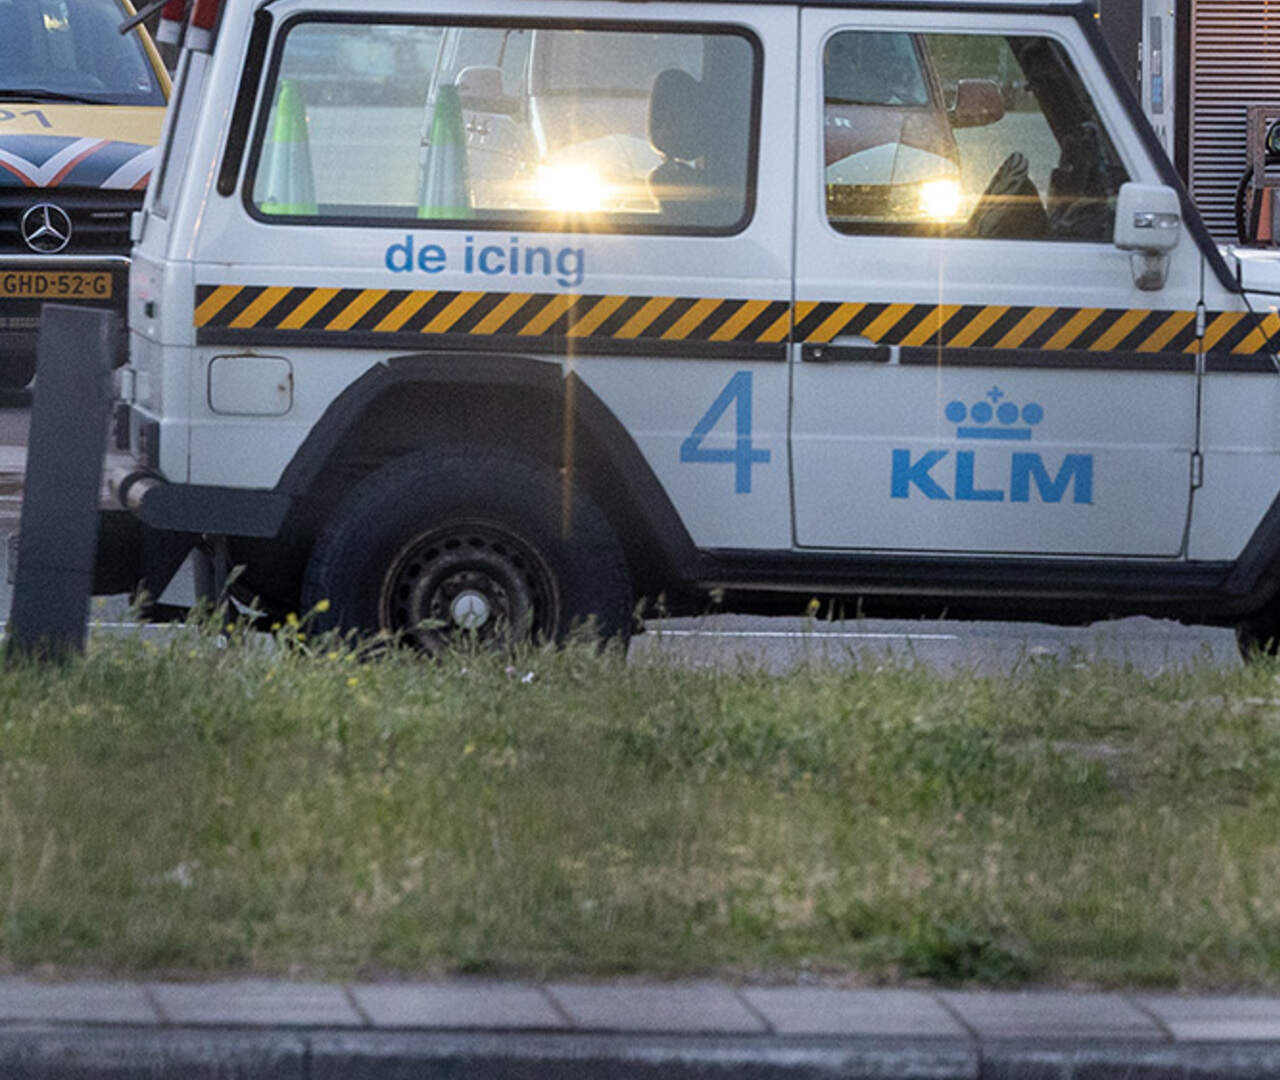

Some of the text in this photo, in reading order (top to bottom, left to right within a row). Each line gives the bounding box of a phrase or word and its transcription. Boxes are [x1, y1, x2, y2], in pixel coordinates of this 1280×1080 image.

[3, 274, 107, 295] GHD-52-G
[384, 234, 585, 288] de icing
[678, 370, 772, 494] 4
[889, 449, 1095, 505] KLM
